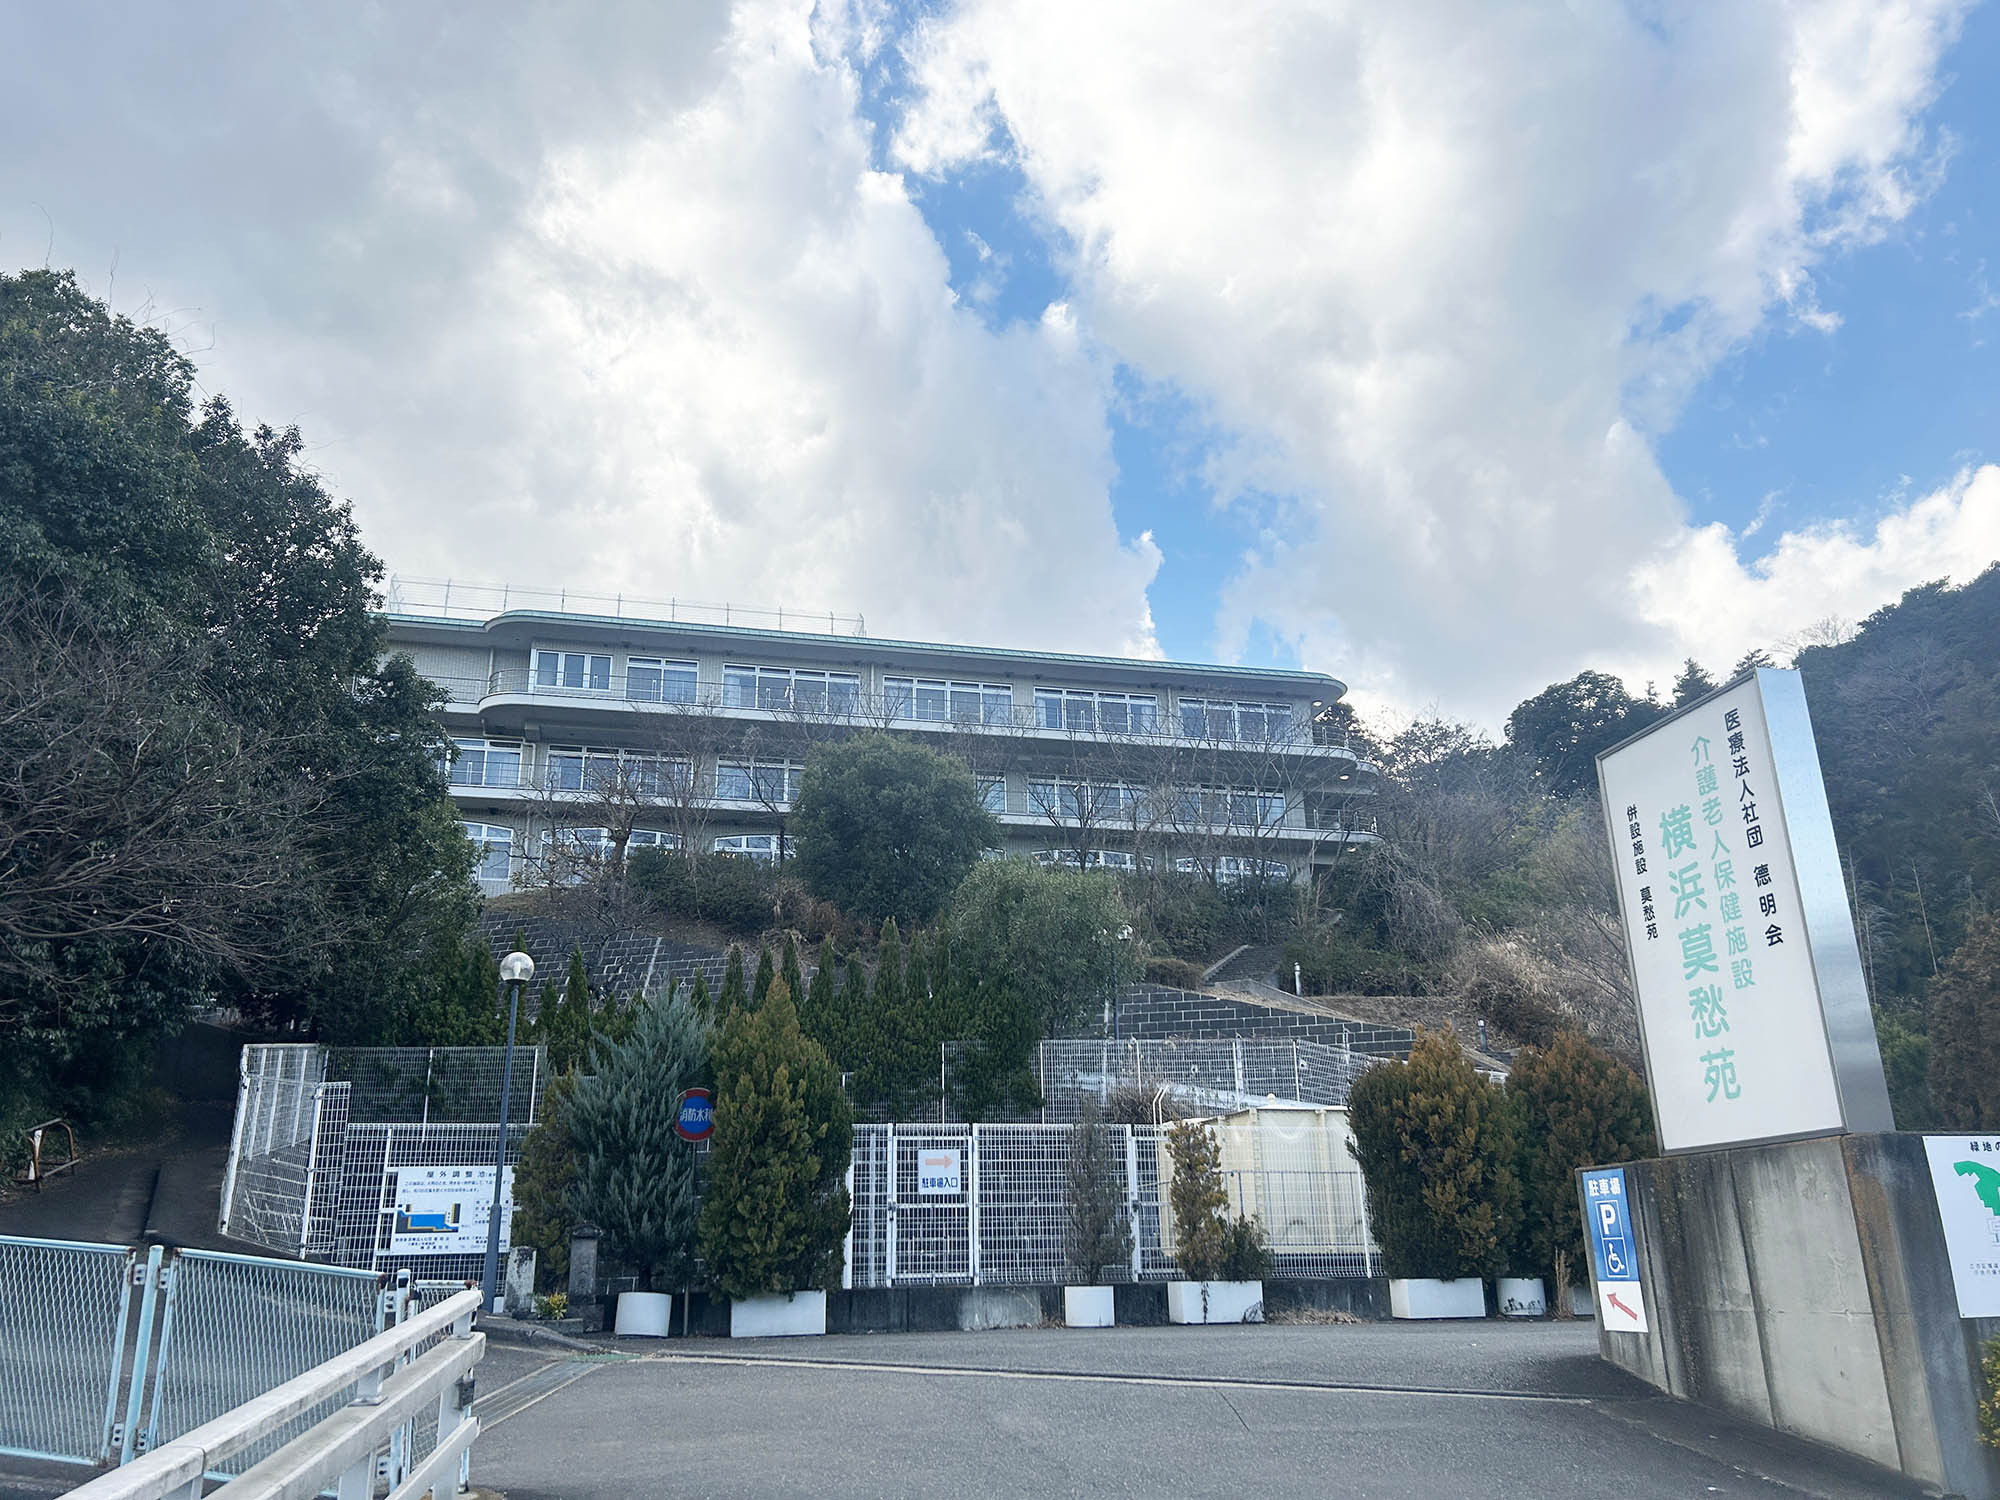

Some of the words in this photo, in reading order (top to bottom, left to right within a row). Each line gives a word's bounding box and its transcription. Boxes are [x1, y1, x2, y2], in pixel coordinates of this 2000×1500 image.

[1626, 804, 1648, 875] 併設施設
[1640, 886, 1658, 940] 莫愁苑
[1690, 735, 1755, 990] 介護老人保健施設
[1724, 708, 1764, 848] 医療法人社団
[1753, 863, 1784, 948] 徳明会
[1659, 803, 1742, 1104] 横浜莫愁苑
[922, 1177, 958, 1188] 駐車場入口
[1587, 1177, 1621, 1197] 駐車場
[1600, 1204, 1616, 1235] P
